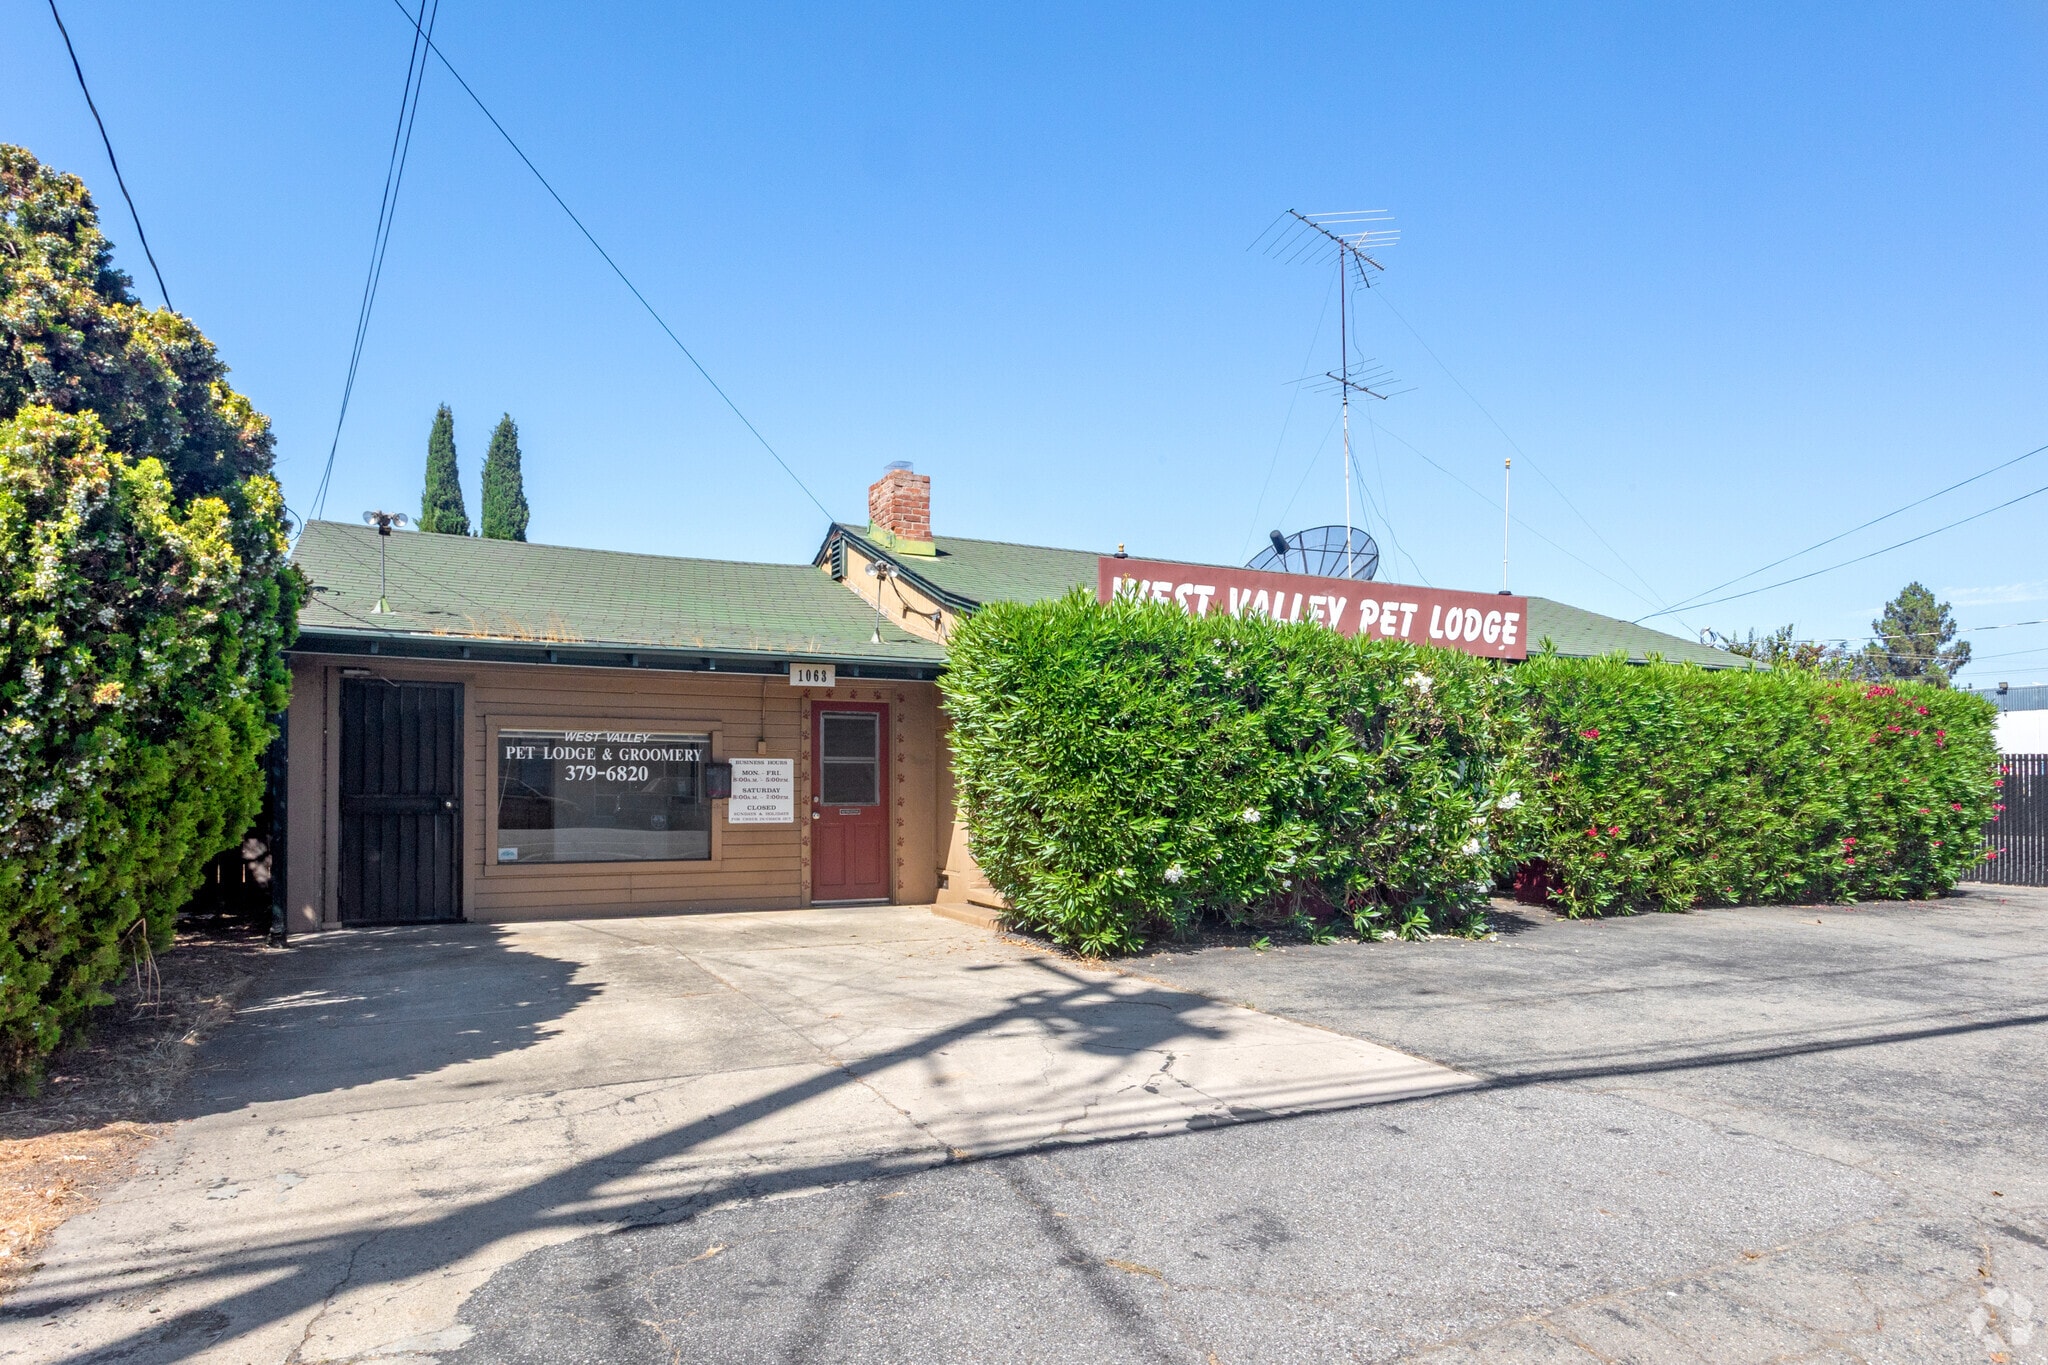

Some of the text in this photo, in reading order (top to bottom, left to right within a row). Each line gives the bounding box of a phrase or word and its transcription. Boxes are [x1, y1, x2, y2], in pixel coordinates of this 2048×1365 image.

[1112, 576, 1521, 645] WEST VALLEY PET LODGE
[798, 669, 827, 683] 1063
[563, 732, 651, 743] WEST VALLEY
[505, 746, 702, 762] PET LODGE & GROOMERY
[565, 765, 649, 781] 379-6820
